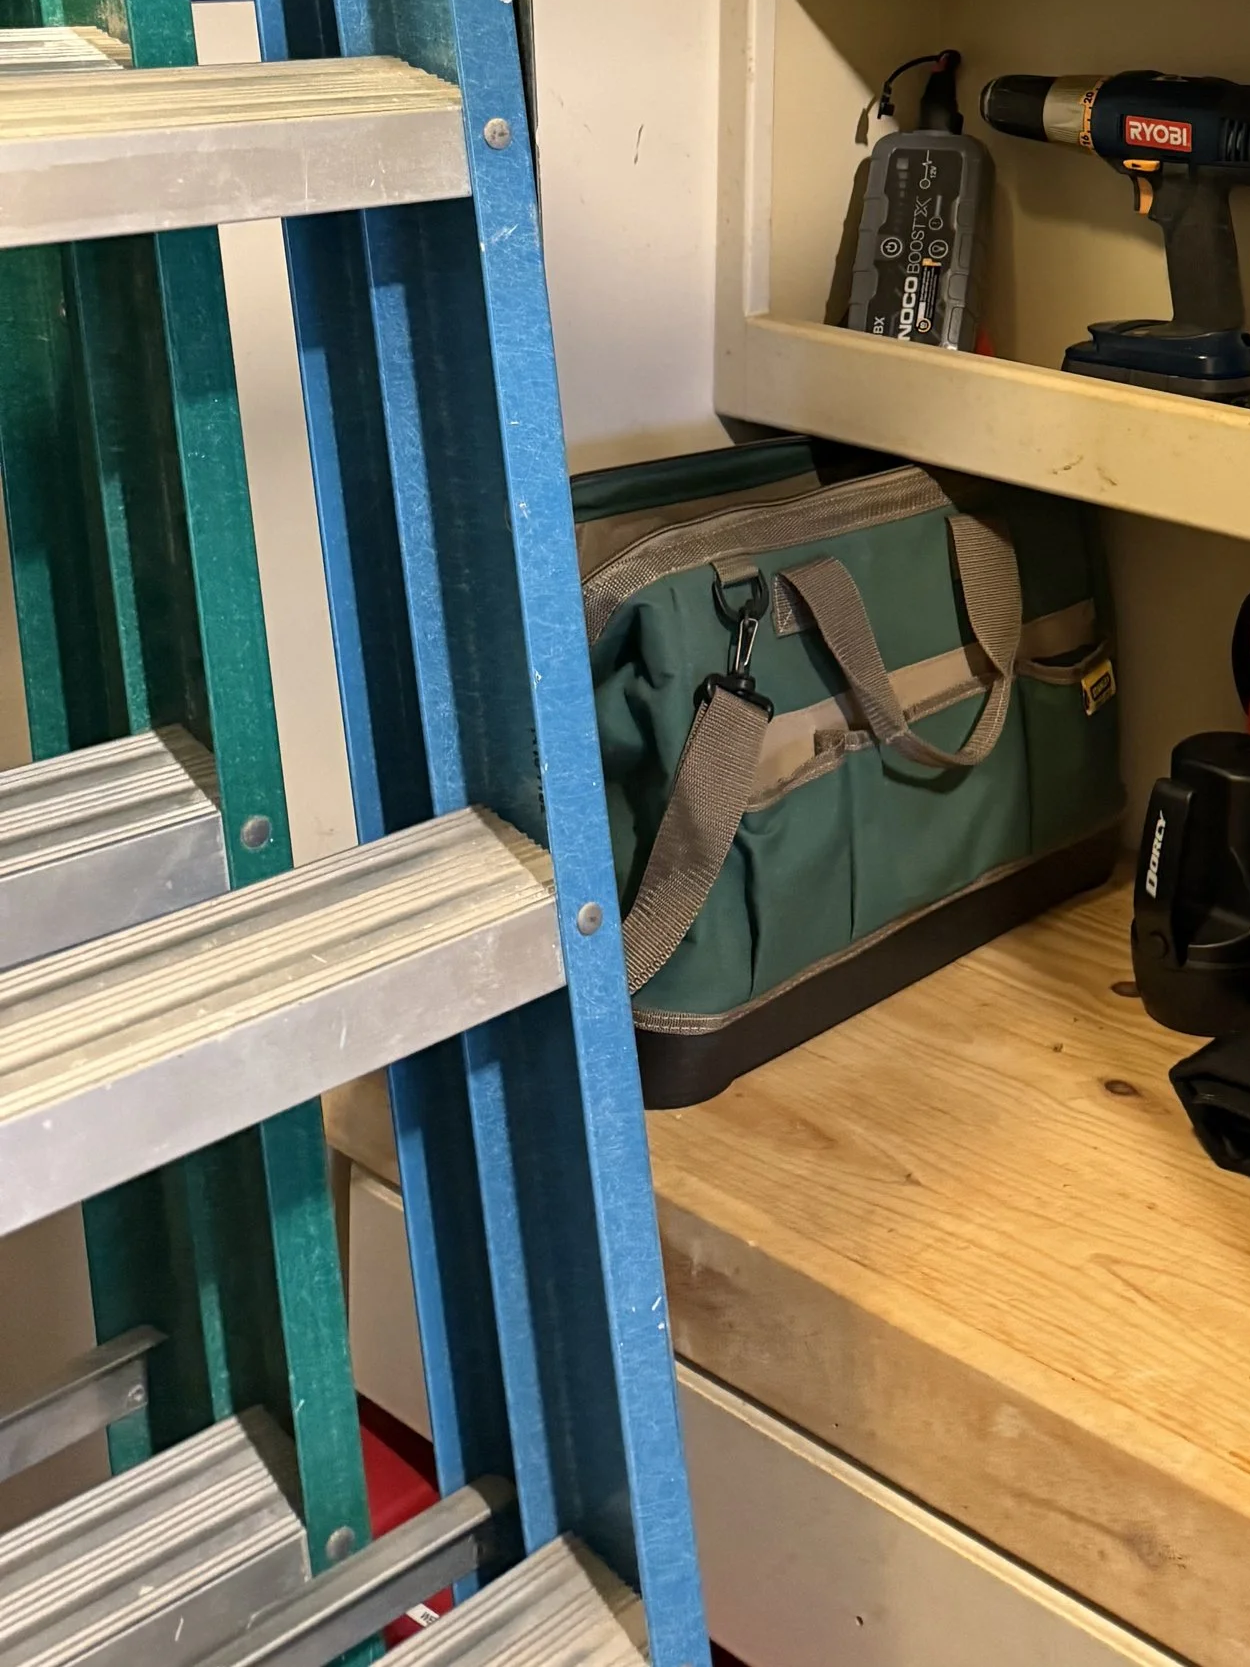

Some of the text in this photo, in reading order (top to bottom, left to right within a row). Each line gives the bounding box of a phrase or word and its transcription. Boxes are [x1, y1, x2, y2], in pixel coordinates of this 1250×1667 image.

[1083, 91, 1095, 104] 20
[1128, 120, 1188, 147] RYOBI
[898, 276, 918, 341] NOCO
